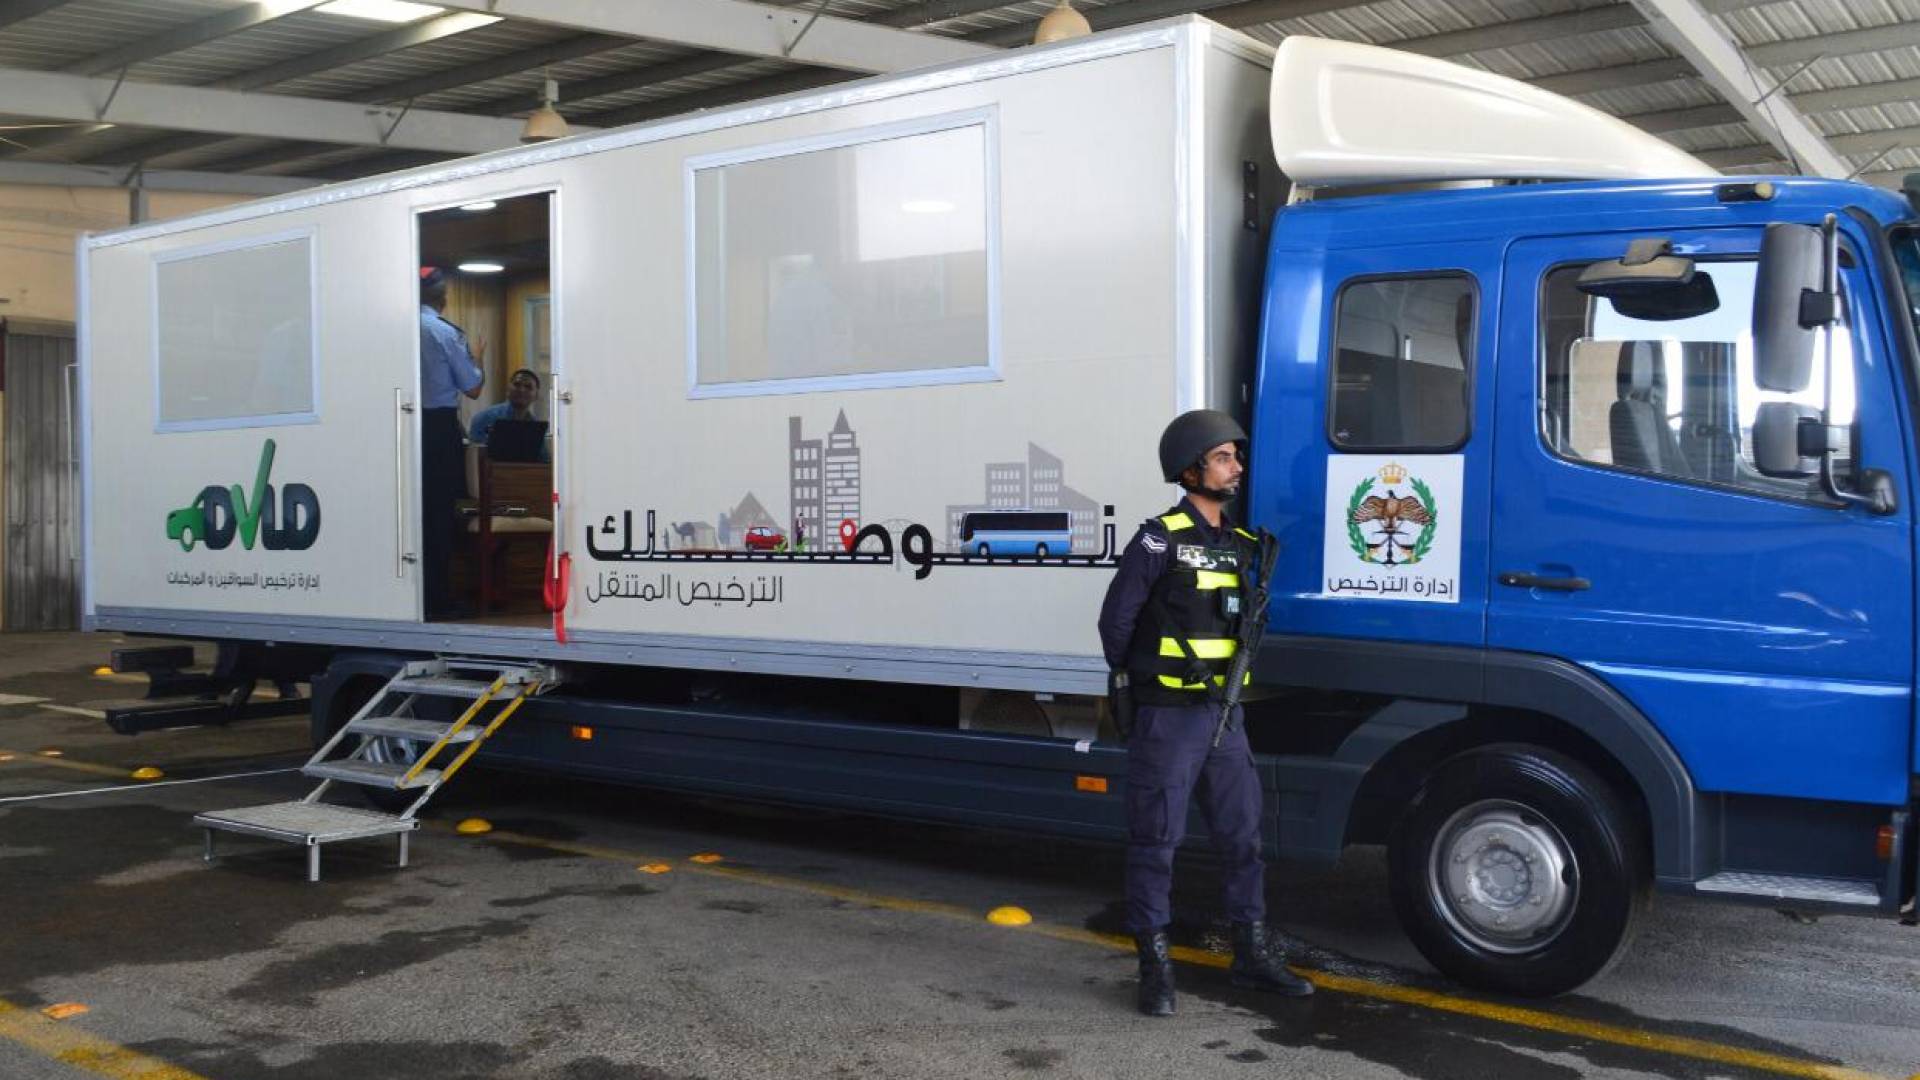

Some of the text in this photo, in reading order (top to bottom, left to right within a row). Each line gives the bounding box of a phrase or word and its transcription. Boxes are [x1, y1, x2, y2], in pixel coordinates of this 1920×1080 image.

[203, 438, 321, 551] DVLD
[166, 571, 206, 587] المركبات
[215, 571, 259, 590] السواقين
[261, 572, 296, 590] ترخيص
[586, 570, 783, 607] الترخيص المتنقل
[1327, 575, 1453, 599] إدارة الترخيص
